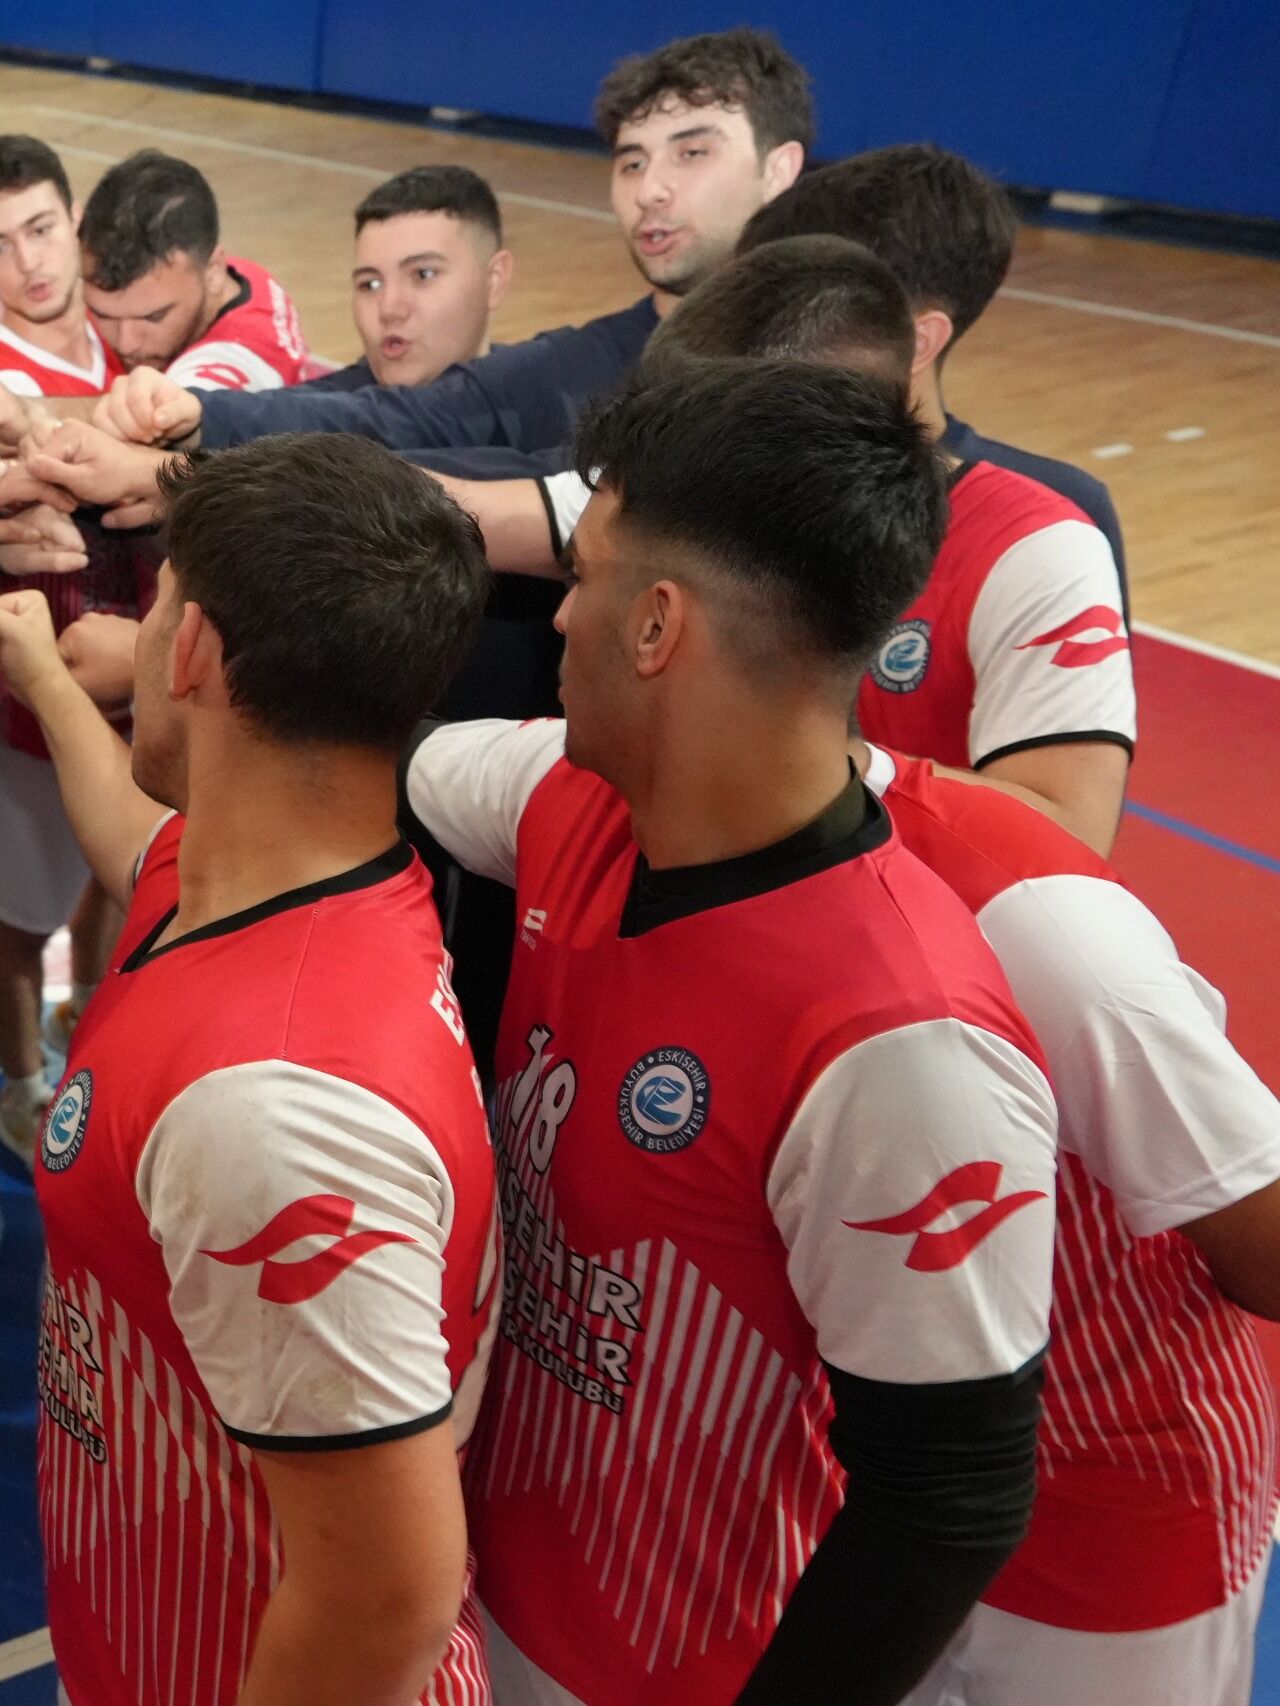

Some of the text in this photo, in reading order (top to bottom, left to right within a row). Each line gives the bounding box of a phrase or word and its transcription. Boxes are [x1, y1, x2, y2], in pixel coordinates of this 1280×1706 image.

[658, 1049, 706, 1091] ESKİŞEHİR
[620, 1061, 705, 1151] BÜYÜKŞEHİR BELEDİYESİ
